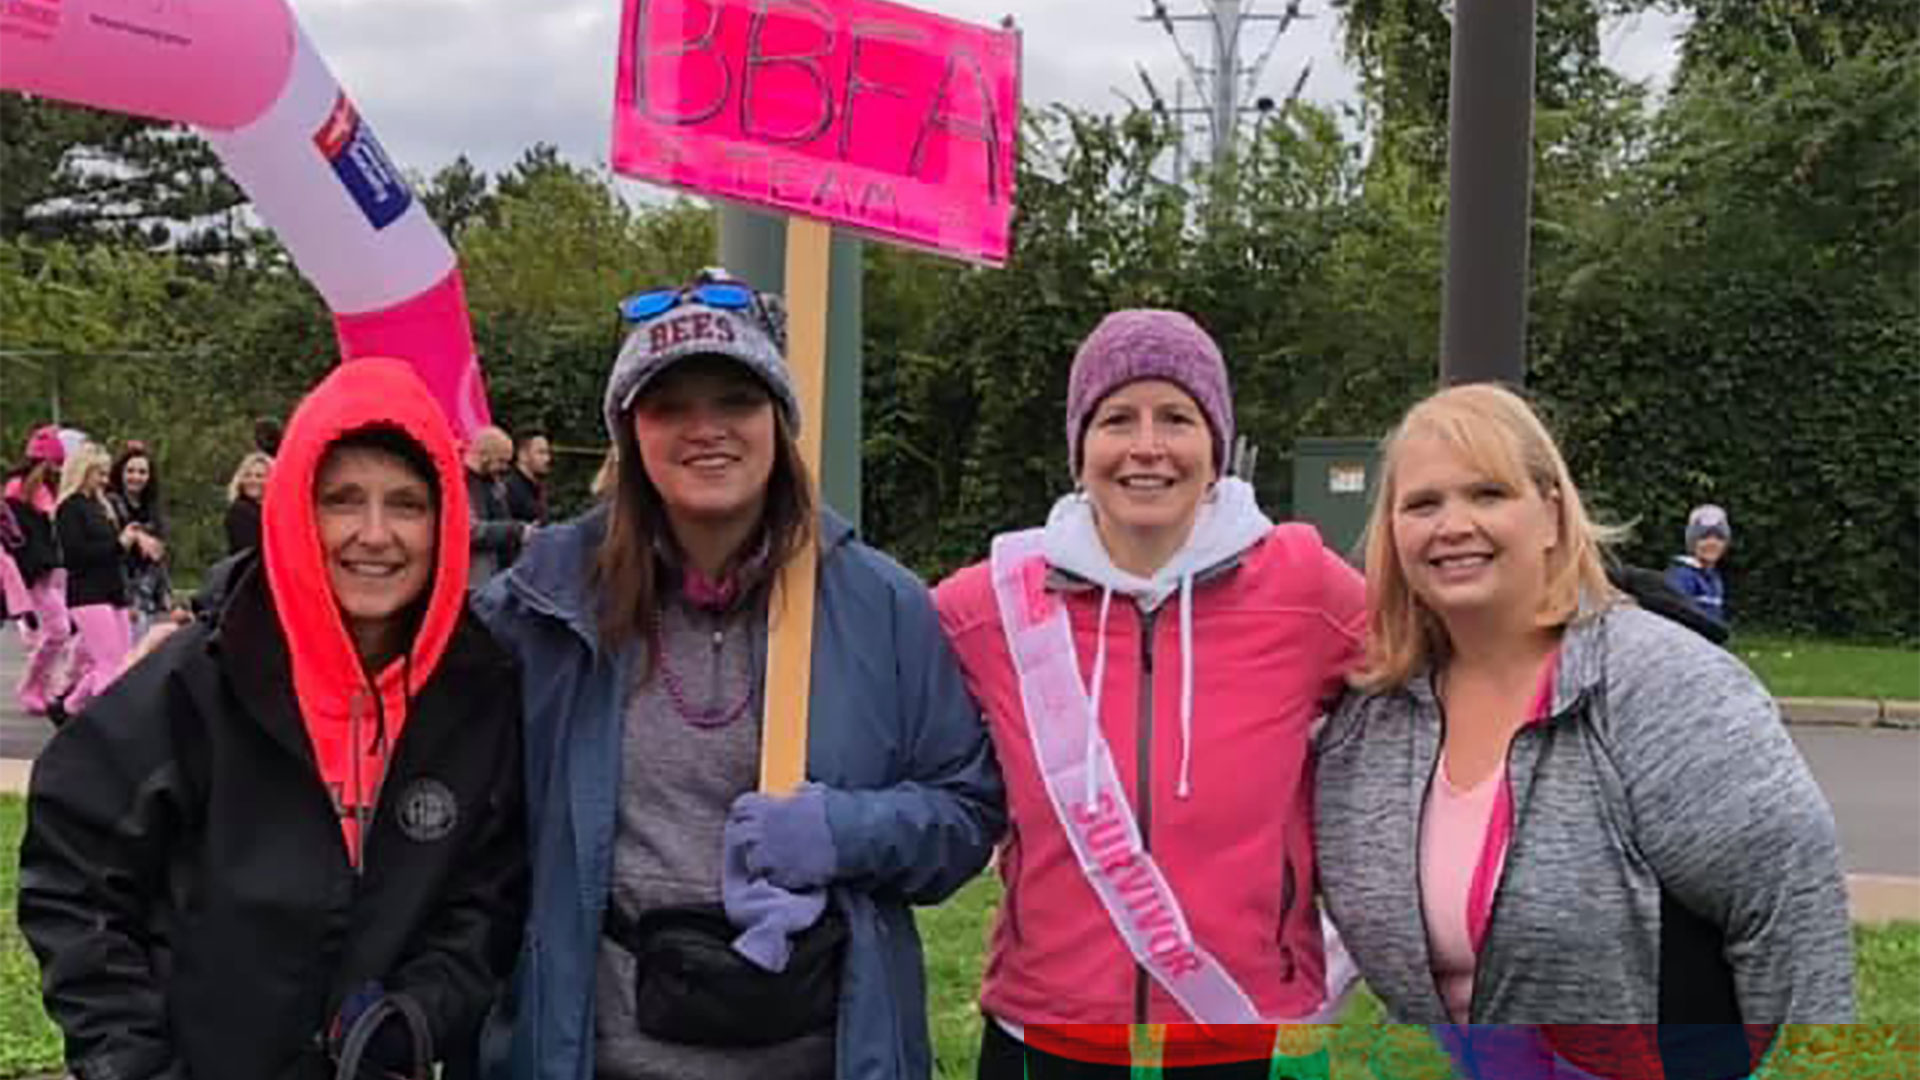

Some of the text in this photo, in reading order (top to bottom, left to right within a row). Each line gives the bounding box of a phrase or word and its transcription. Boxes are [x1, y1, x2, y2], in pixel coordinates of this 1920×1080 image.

[636, 0, 1000, 205] BBFA
[725, 146, 901, 218] TEAM
[650, 312, 735, 355] BEES
[1072, 789, 1199, 977] SURVIVOR
